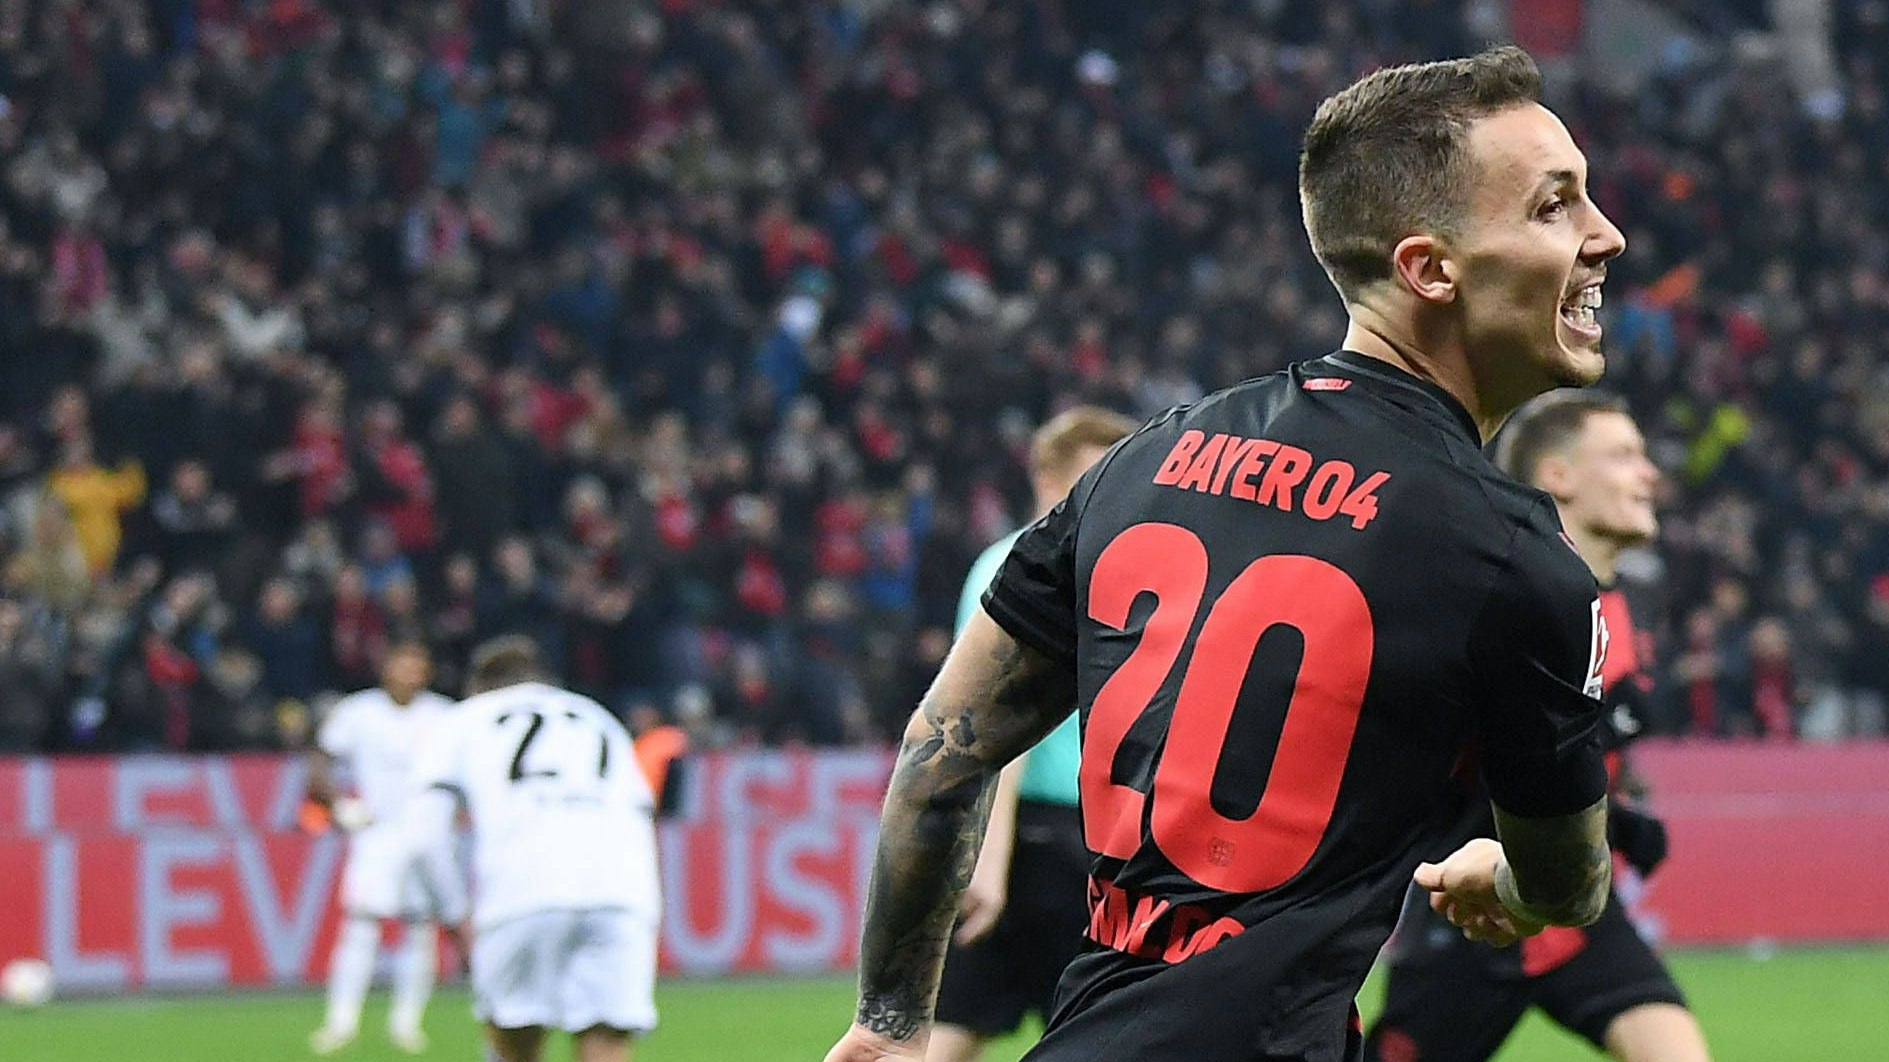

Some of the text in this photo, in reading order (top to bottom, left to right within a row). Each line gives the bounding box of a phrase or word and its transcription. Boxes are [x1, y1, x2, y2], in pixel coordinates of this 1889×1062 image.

[1152, 429, 1392, 530] BAYER 04
[1080, 521, 1375, 894] 20
